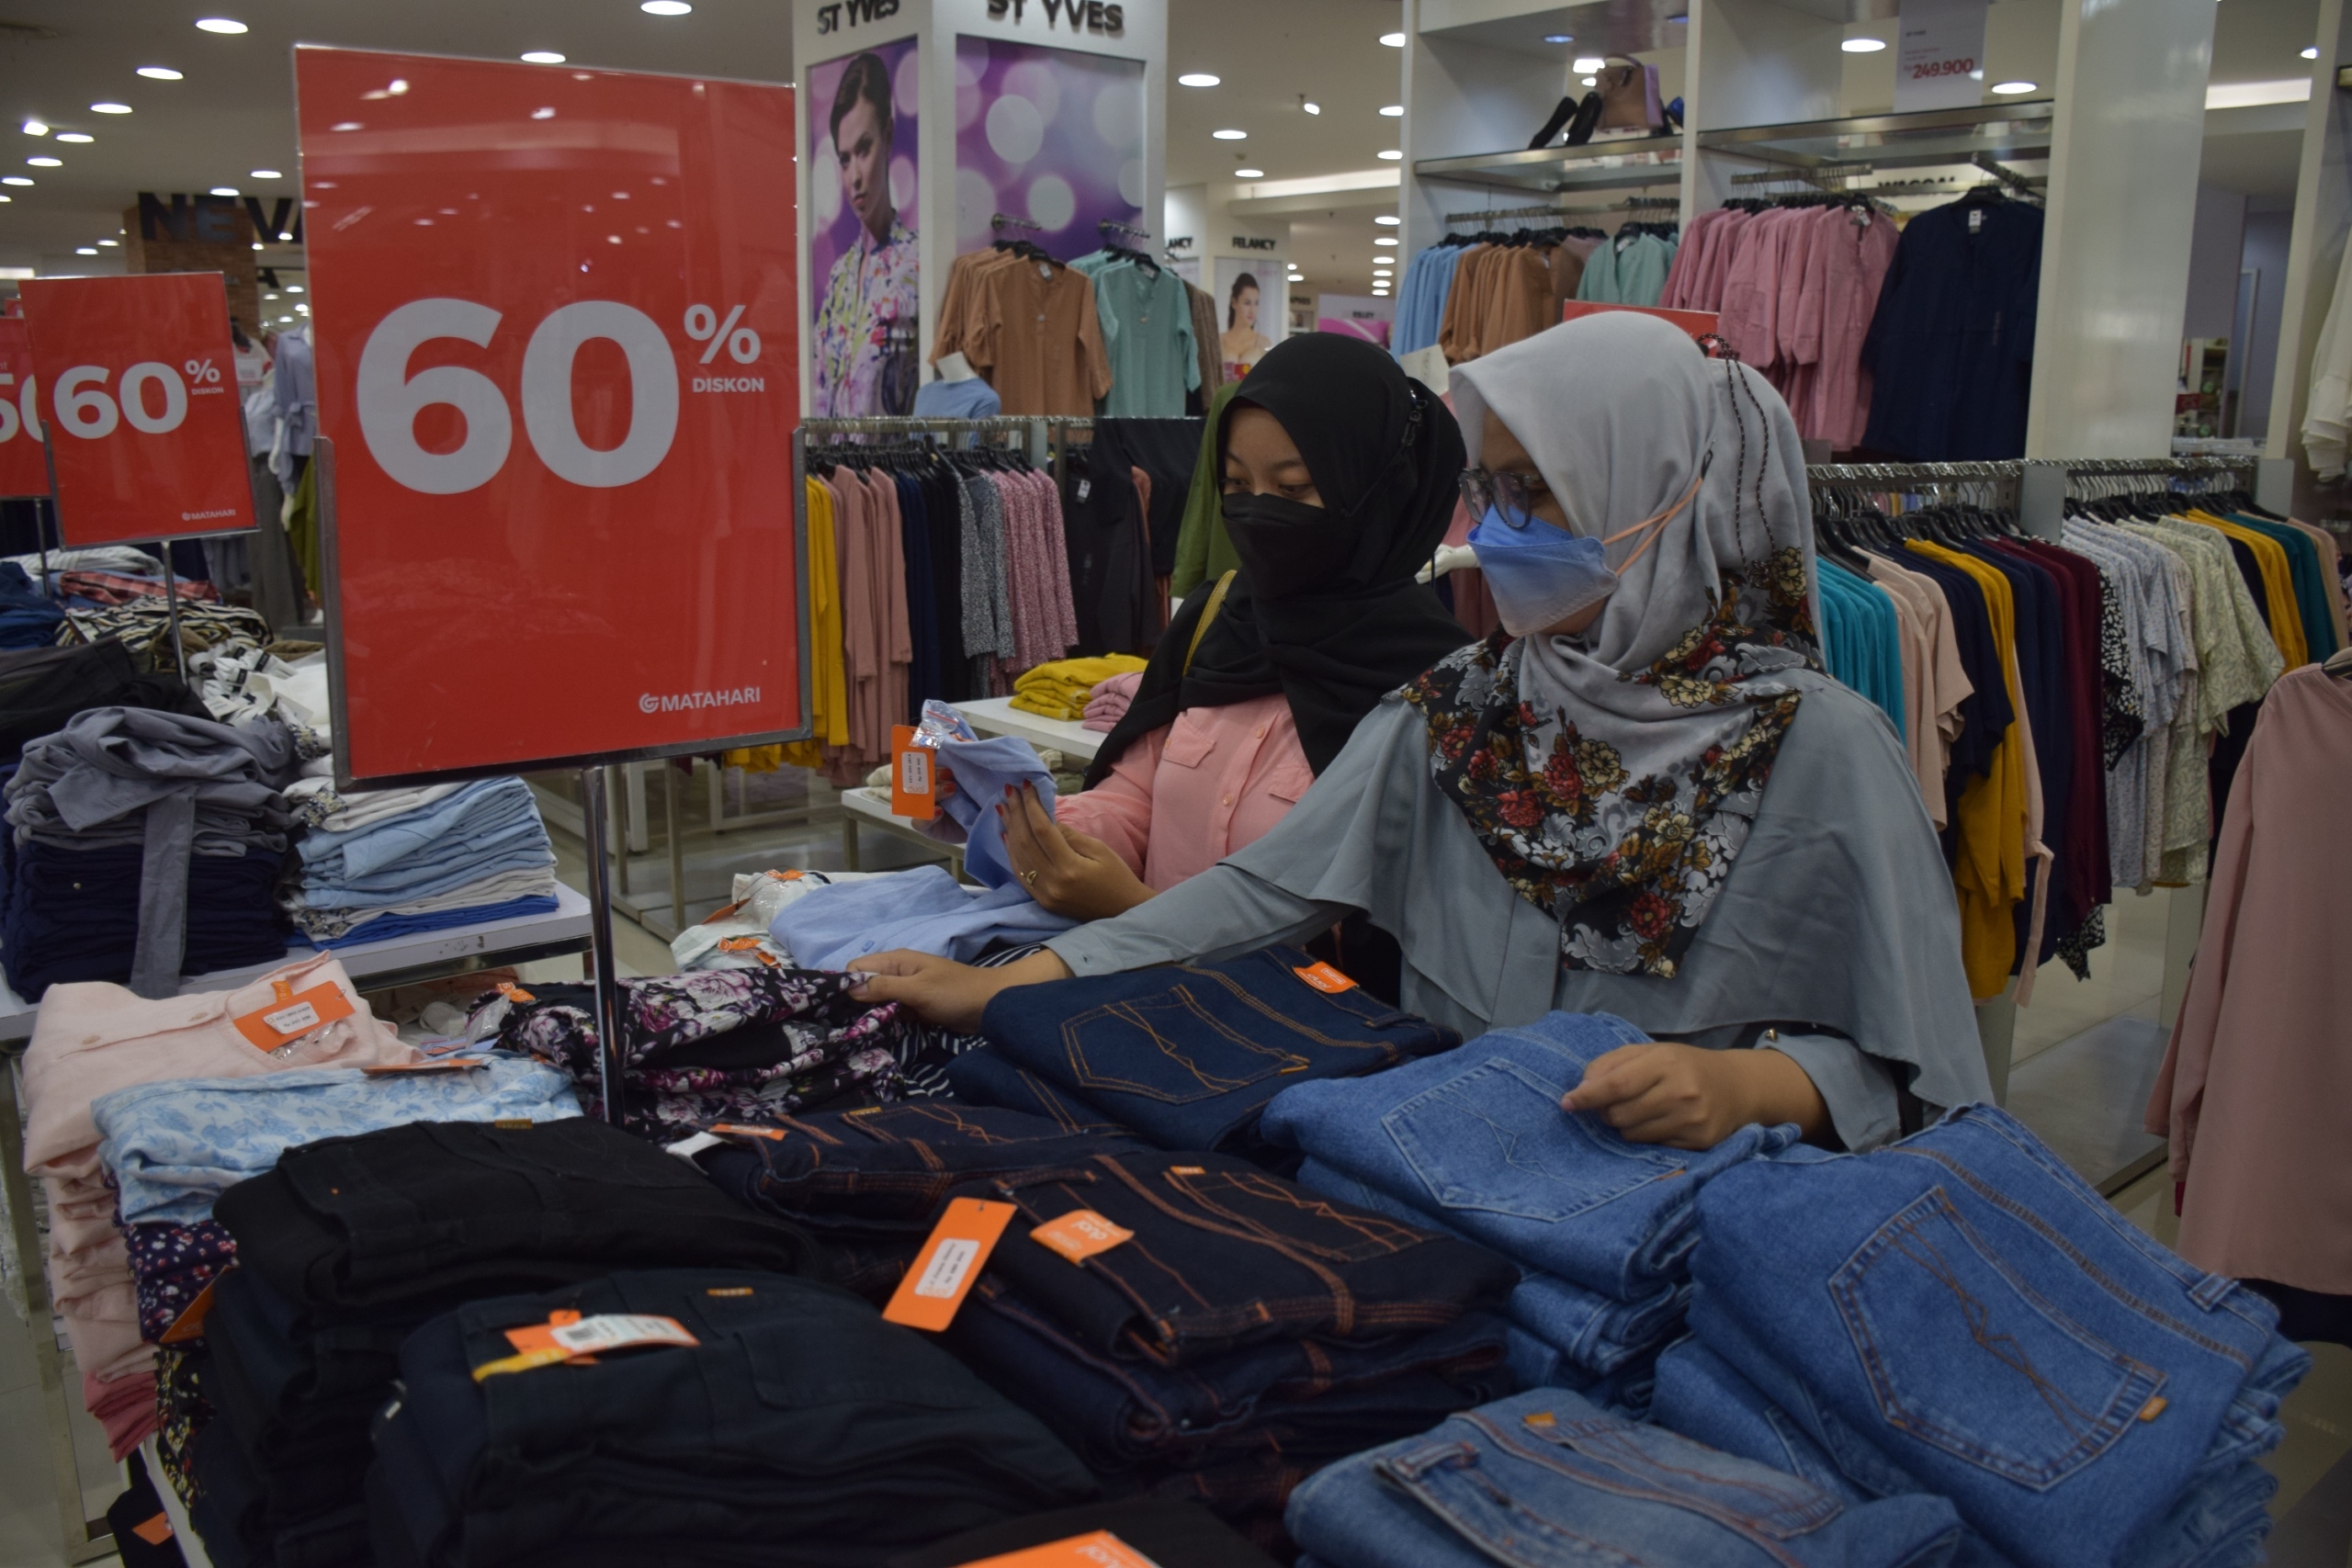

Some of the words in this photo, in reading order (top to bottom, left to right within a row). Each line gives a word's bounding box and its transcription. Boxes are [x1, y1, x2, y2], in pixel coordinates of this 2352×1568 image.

[817, 4, 842, 35] ST
[847, 0, 899, 28] YVES
[1041, 0, 1125, 33] YVES
[139, 192, 303, 244] NEV
[1232, 236, 1276, 251] FELANCY
[191, 386, 224, 396] DISKON
[692, 378, 765, 393] DISKON
[191, 508, 236, 521] MATAHARI
[661, 686, 761, 713] MATAHARI
